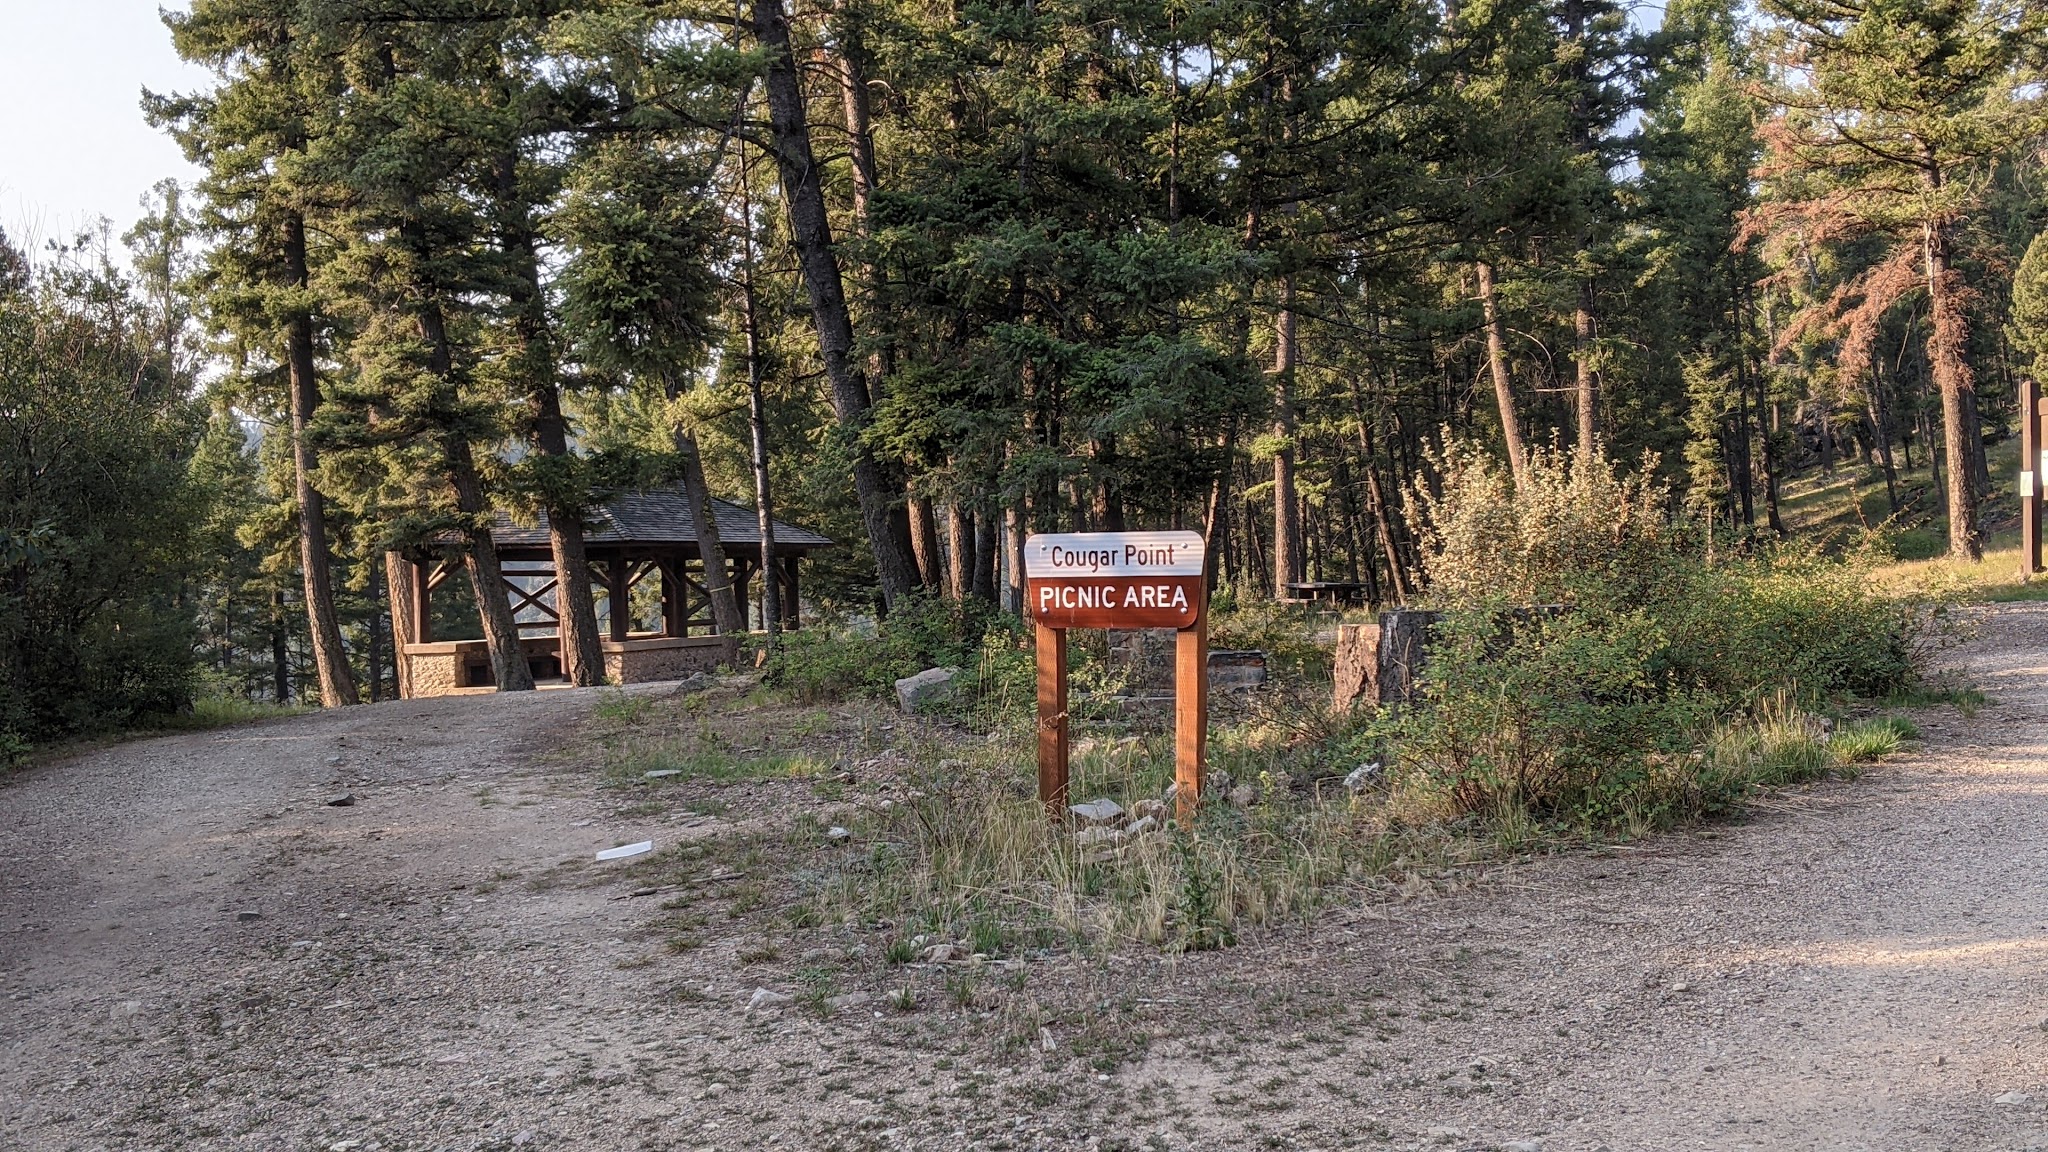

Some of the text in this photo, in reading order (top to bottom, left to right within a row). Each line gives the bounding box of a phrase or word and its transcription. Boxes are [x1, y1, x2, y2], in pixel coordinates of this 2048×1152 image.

[1051, 543, 1175, 573] Cougar Point
[1040, 585, 1188, 609] PICNIC AREA
